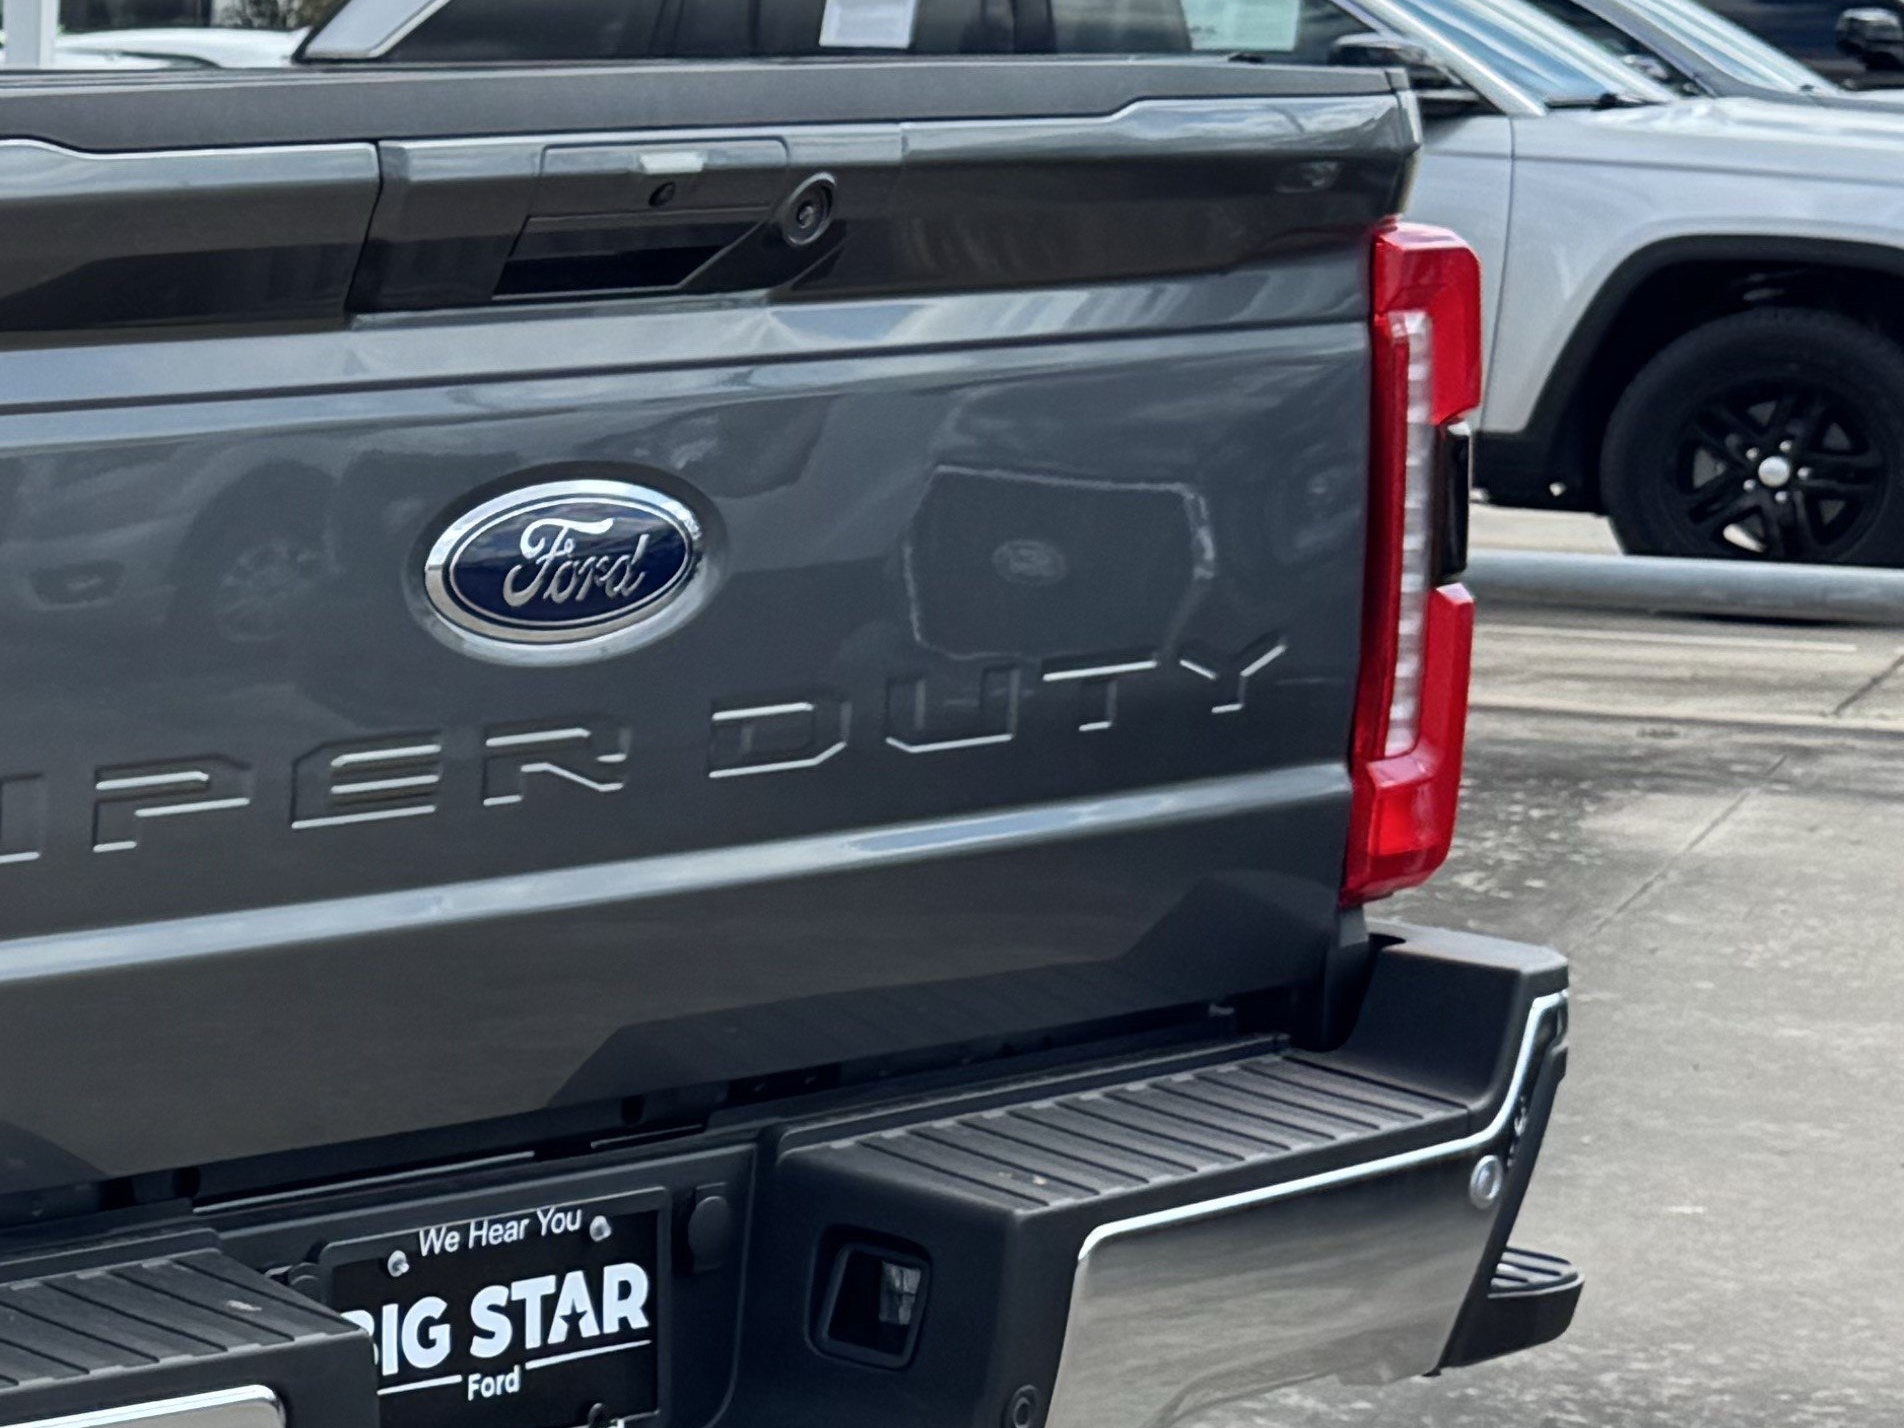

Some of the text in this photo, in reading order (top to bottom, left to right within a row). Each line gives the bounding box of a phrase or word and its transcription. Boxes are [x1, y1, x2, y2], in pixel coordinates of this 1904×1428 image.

[502, 517, 650, 607] Ford
[709, 630, 1290, 779] DUTY
[418, 1207, 583, 1257] We Hear You
[469, 1262, 650, 1359] STAR
[467, 1364, 522, 1401] Ford
